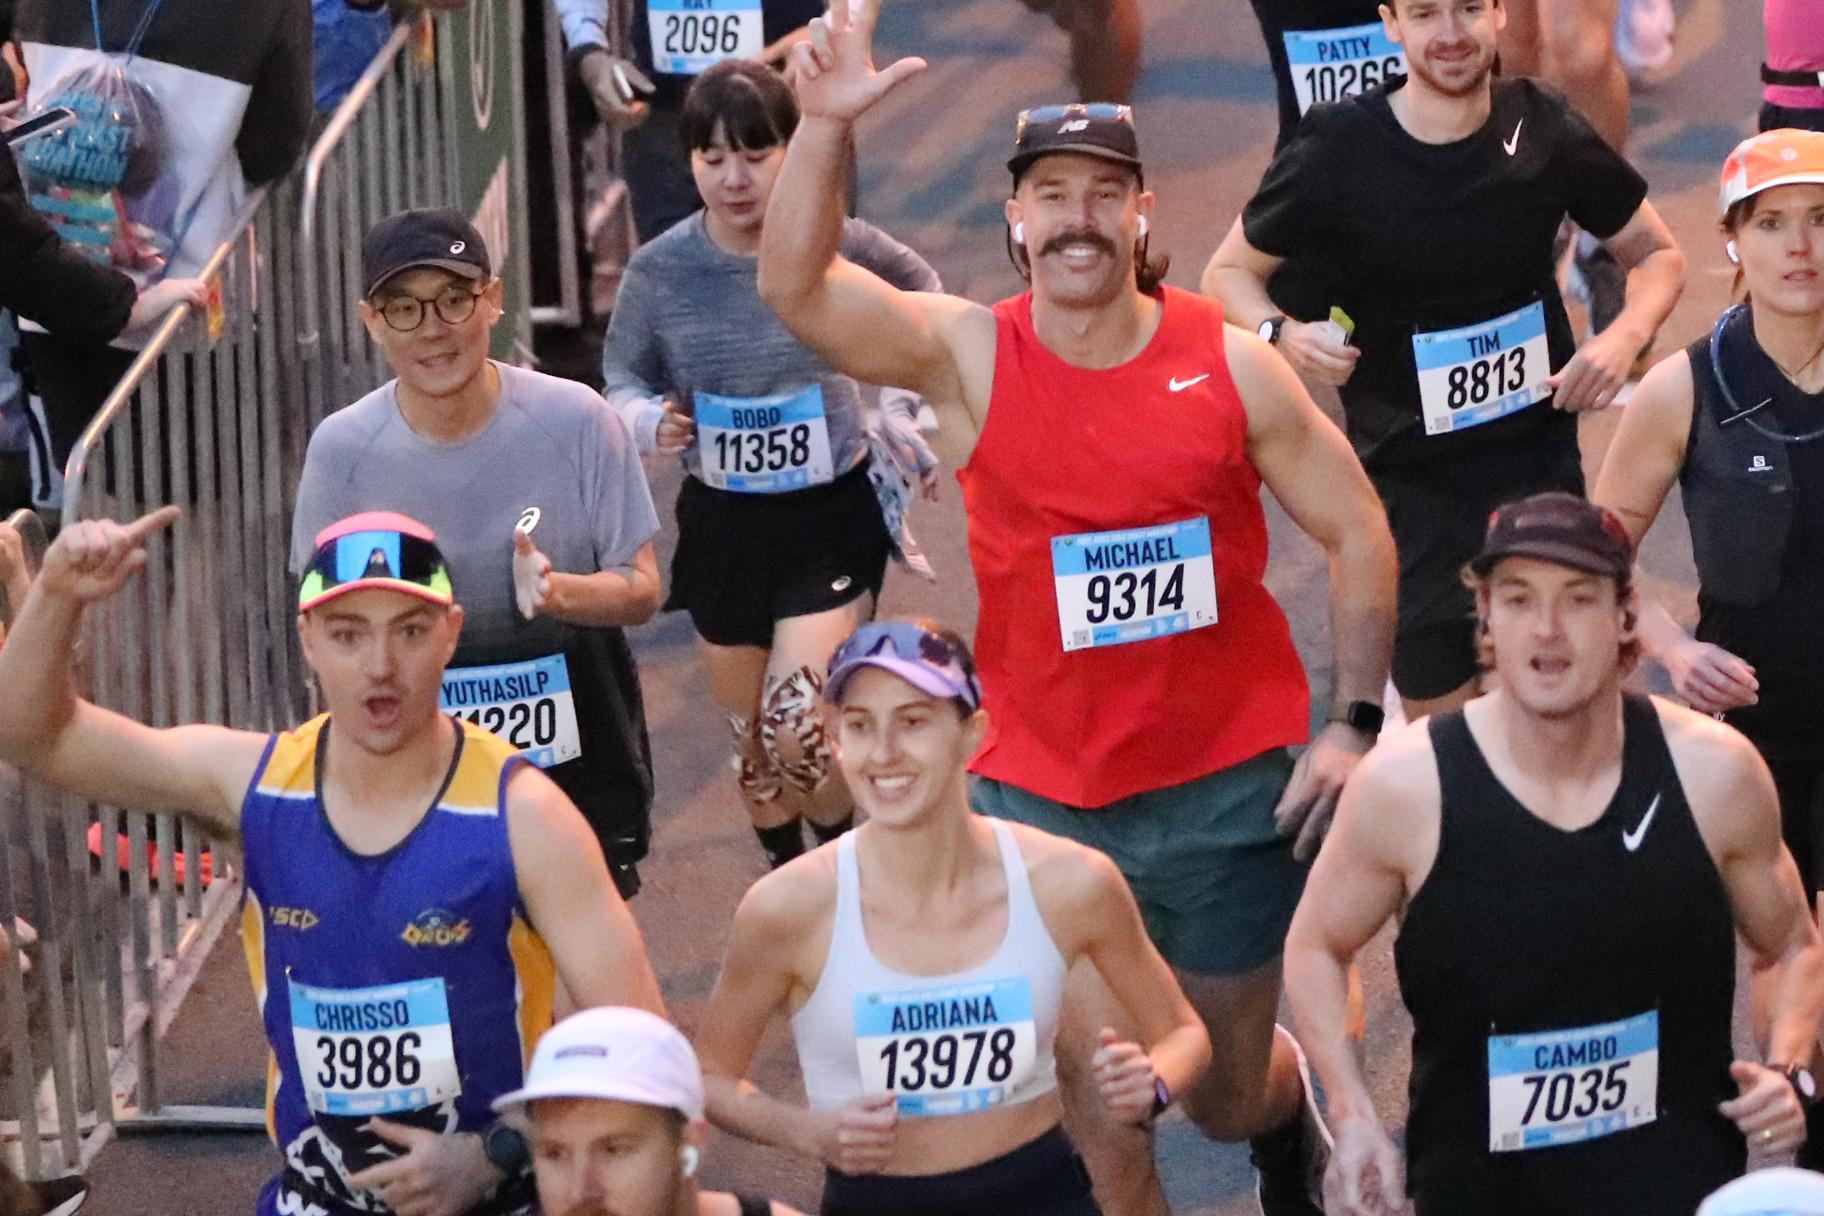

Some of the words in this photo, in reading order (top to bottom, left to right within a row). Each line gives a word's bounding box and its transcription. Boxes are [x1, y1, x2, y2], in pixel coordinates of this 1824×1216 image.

[665, 15, 741, 54] 2096
[1317, 36, 1370, 62] PATTY
[1467, 331, 1501, 358] TIM
[1447, 347, 1526, 410] 8813
[732, 407, 781, 429] BOBO
[715, 423, 810, 473] 11358
[1084, 537, 1181, 572] MICHAEL
[1086, 563, 1185, 624] 9314
[442, 671, 550, 707] YUTHASILP
[454, 698, 556, 750] 220
[315, 999, 409, 1031] CHRISSO
[891, 996, 998, 1033] ADRIANA
[317, 1031, 421, 1090] 3986
[880, 1028, 1016, 1092] 13978
[1534, 1036, 1617, 1071] CAMBO
[1521, 1060, 1631, 1126] 7035
